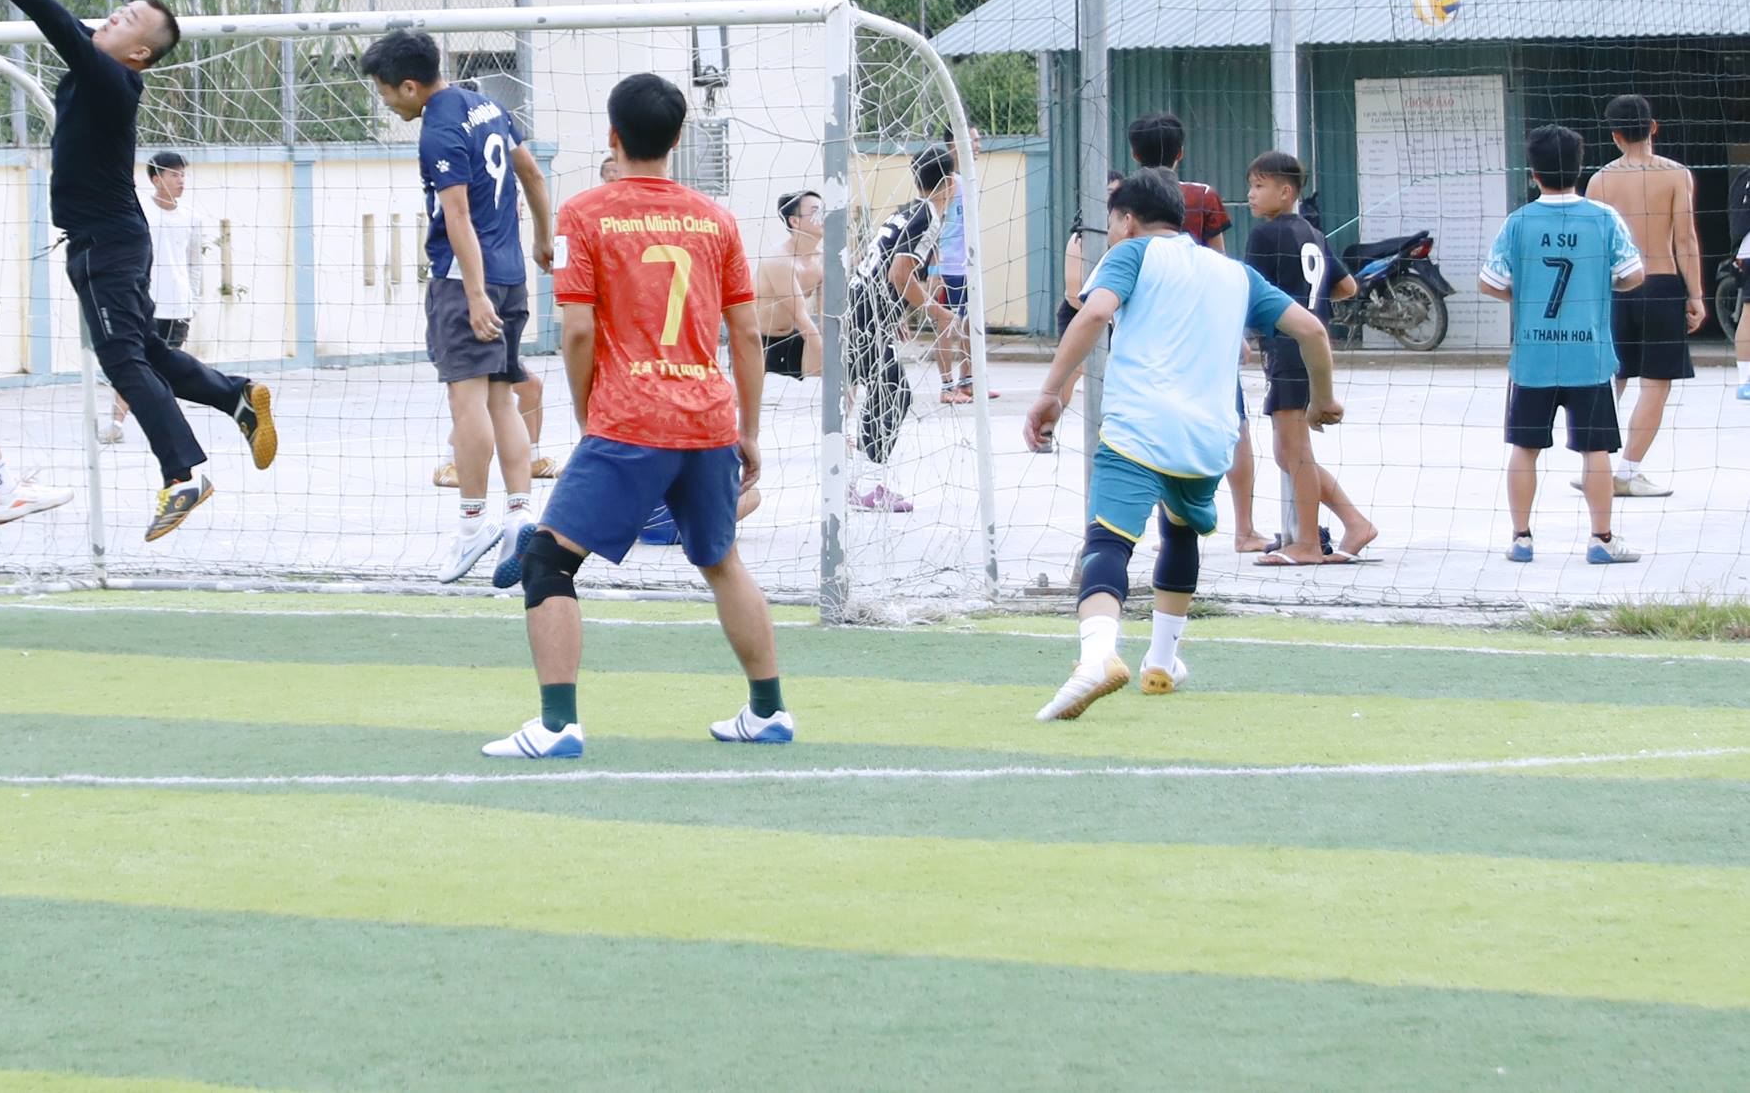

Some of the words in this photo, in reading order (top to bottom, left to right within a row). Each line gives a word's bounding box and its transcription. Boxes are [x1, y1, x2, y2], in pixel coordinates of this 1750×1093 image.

[483, 132, 506, 210] 9
[644, 214, 682, 233] Minh
[1540, 233, 1551, 247] A
[641, 244, 691, 345] 7
[1301, 242, 1325, 309] 9
[1542, 256, 1574, 319] 7
[1532, 329, 1568, 342] THANH
